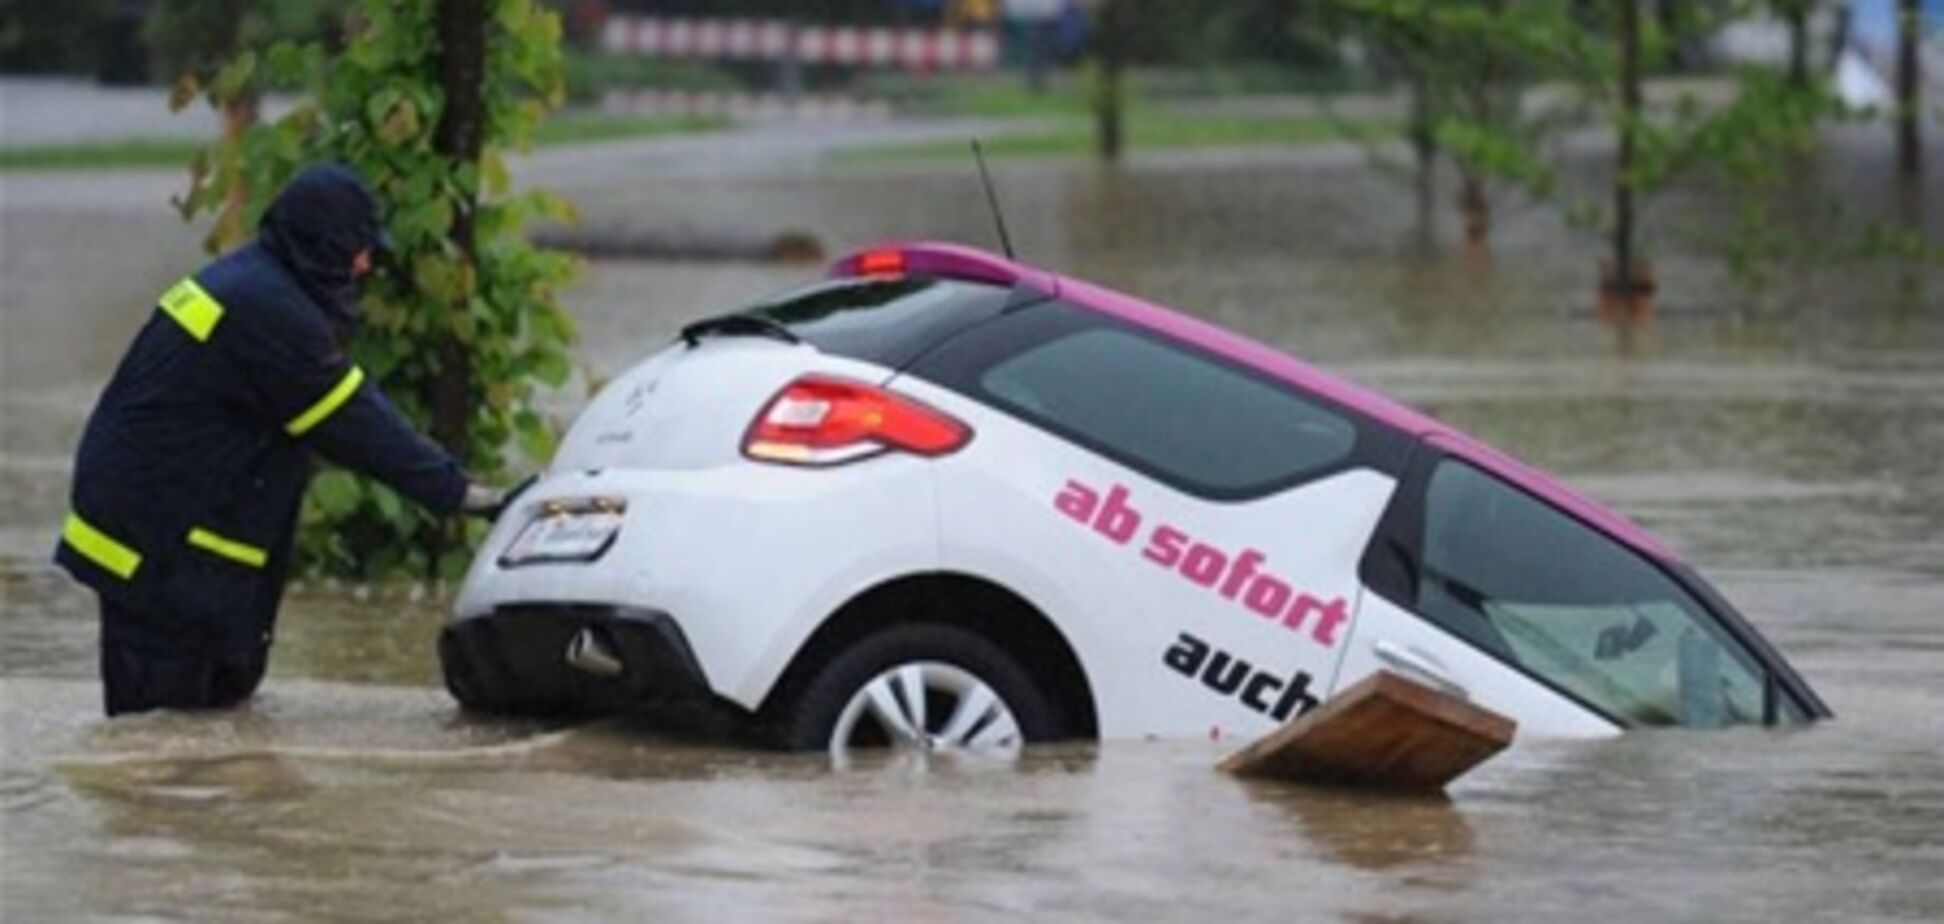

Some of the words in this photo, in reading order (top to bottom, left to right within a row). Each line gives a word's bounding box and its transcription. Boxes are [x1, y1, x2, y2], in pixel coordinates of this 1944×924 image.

[1053, 479, 1141, 545] ab
[1141, 525, 1347, 647] sofort
[1162, 632, 1319, 722] auch
